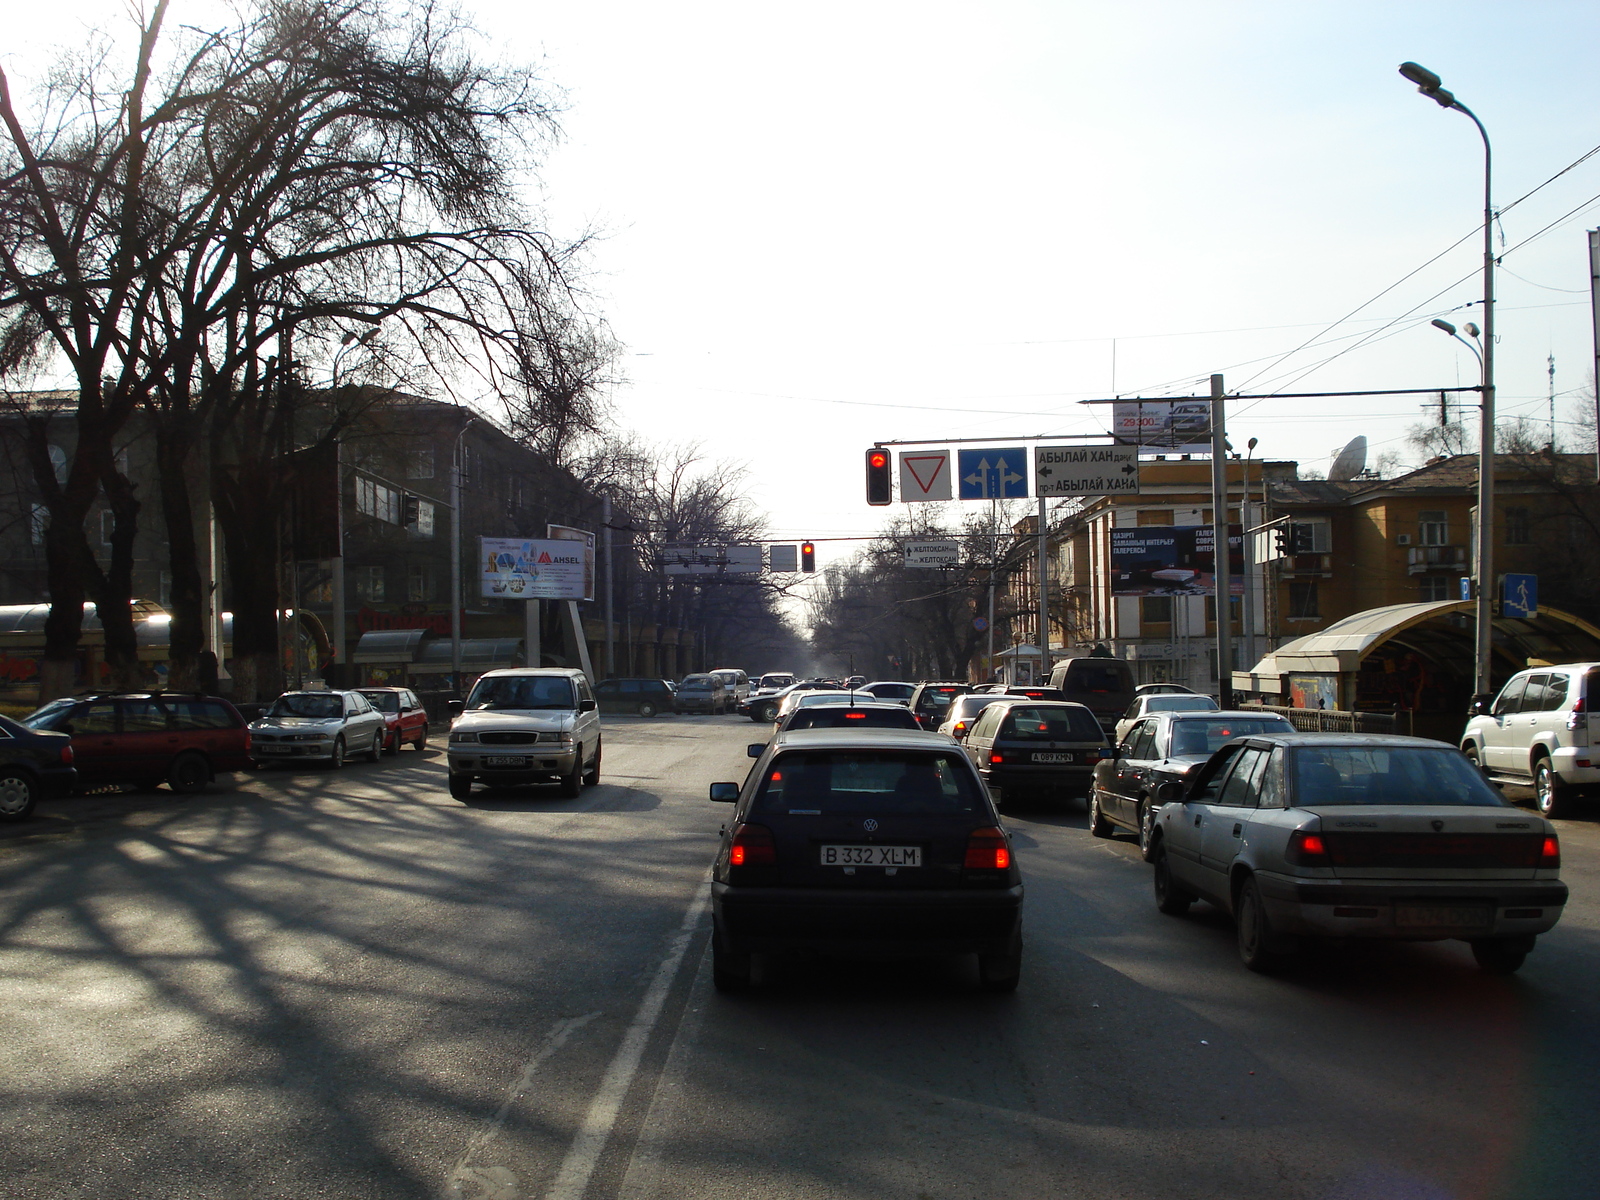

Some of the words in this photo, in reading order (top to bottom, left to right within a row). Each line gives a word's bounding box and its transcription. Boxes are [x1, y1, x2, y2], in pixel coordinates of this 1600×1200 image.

[1123, 418, 1136, 427] 29
[1039, 449, 1088, 464] АБЫЛАЙ
[1090, 450, 1114, 462] ХАН
[1039, 483, 1055, 494] пр-т
[1056, 476, 1105, 491] АБЫЛАЙ
[1107, 478, 1137, 490] ХАНА
[1146, 538, 1175, 546] ИНТЕРЬЕР
[553, 556, 580, 564] AHSEL
[826, 847, 838, 864] B
[843, 848, 873, 864] 332
[879, 848, 916, 865] XLM
